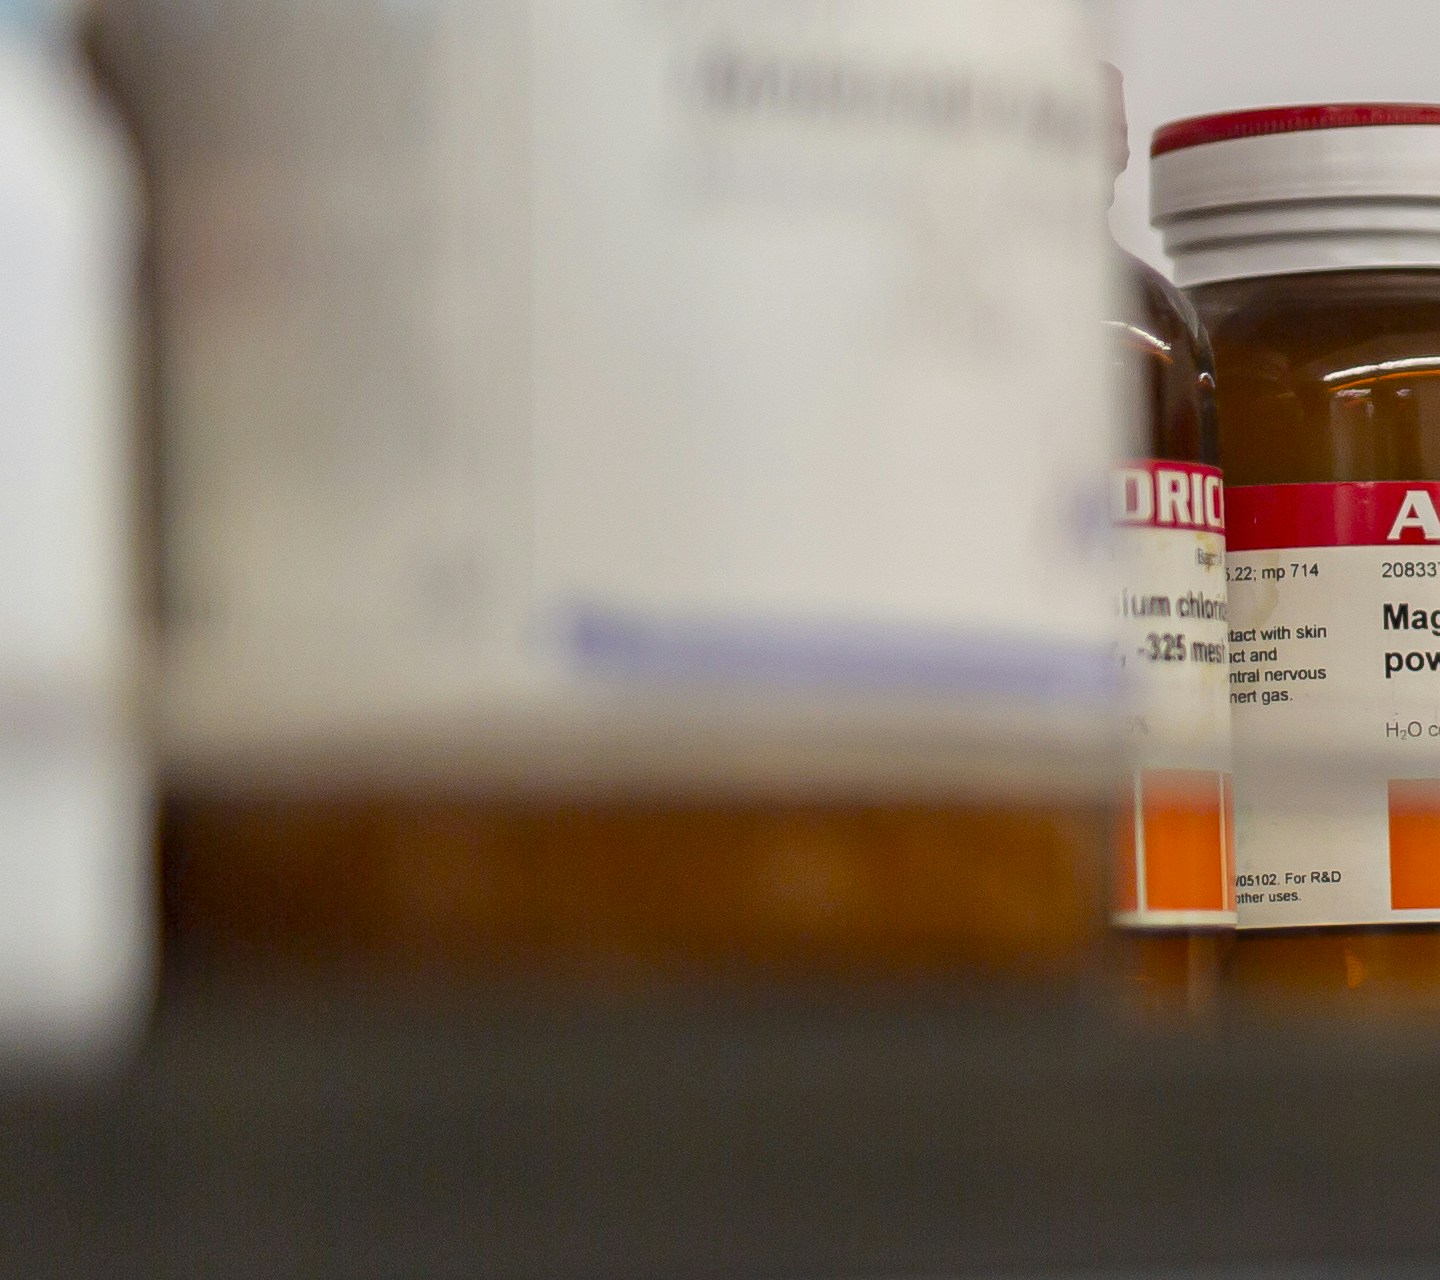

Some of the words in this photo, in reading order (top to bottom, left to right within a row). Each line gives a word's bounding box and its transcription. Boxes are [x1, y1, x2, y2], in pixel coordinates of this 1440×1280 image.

[1121, 470, 1225, 528] DRIC
[1261, 566, 1285, 580] mp
[1290, 563, 1319, 578] 714
[1260, 626, 1291, 641] with
[1296, 624, 1327, 639] skin
[1250, 647, 1277, 662] and
[1229, 668, 1259, 684] ntral
[1264, 668, 1327, 682] nervous
[1230, 690, 1257, 704] nert
[1261, 689, 1293, 706] gas.
[1285, 872, 1306, 884] For
[1310, 870, 1341, 884] R&D
[1268, 891, 1302, 903] uses.
